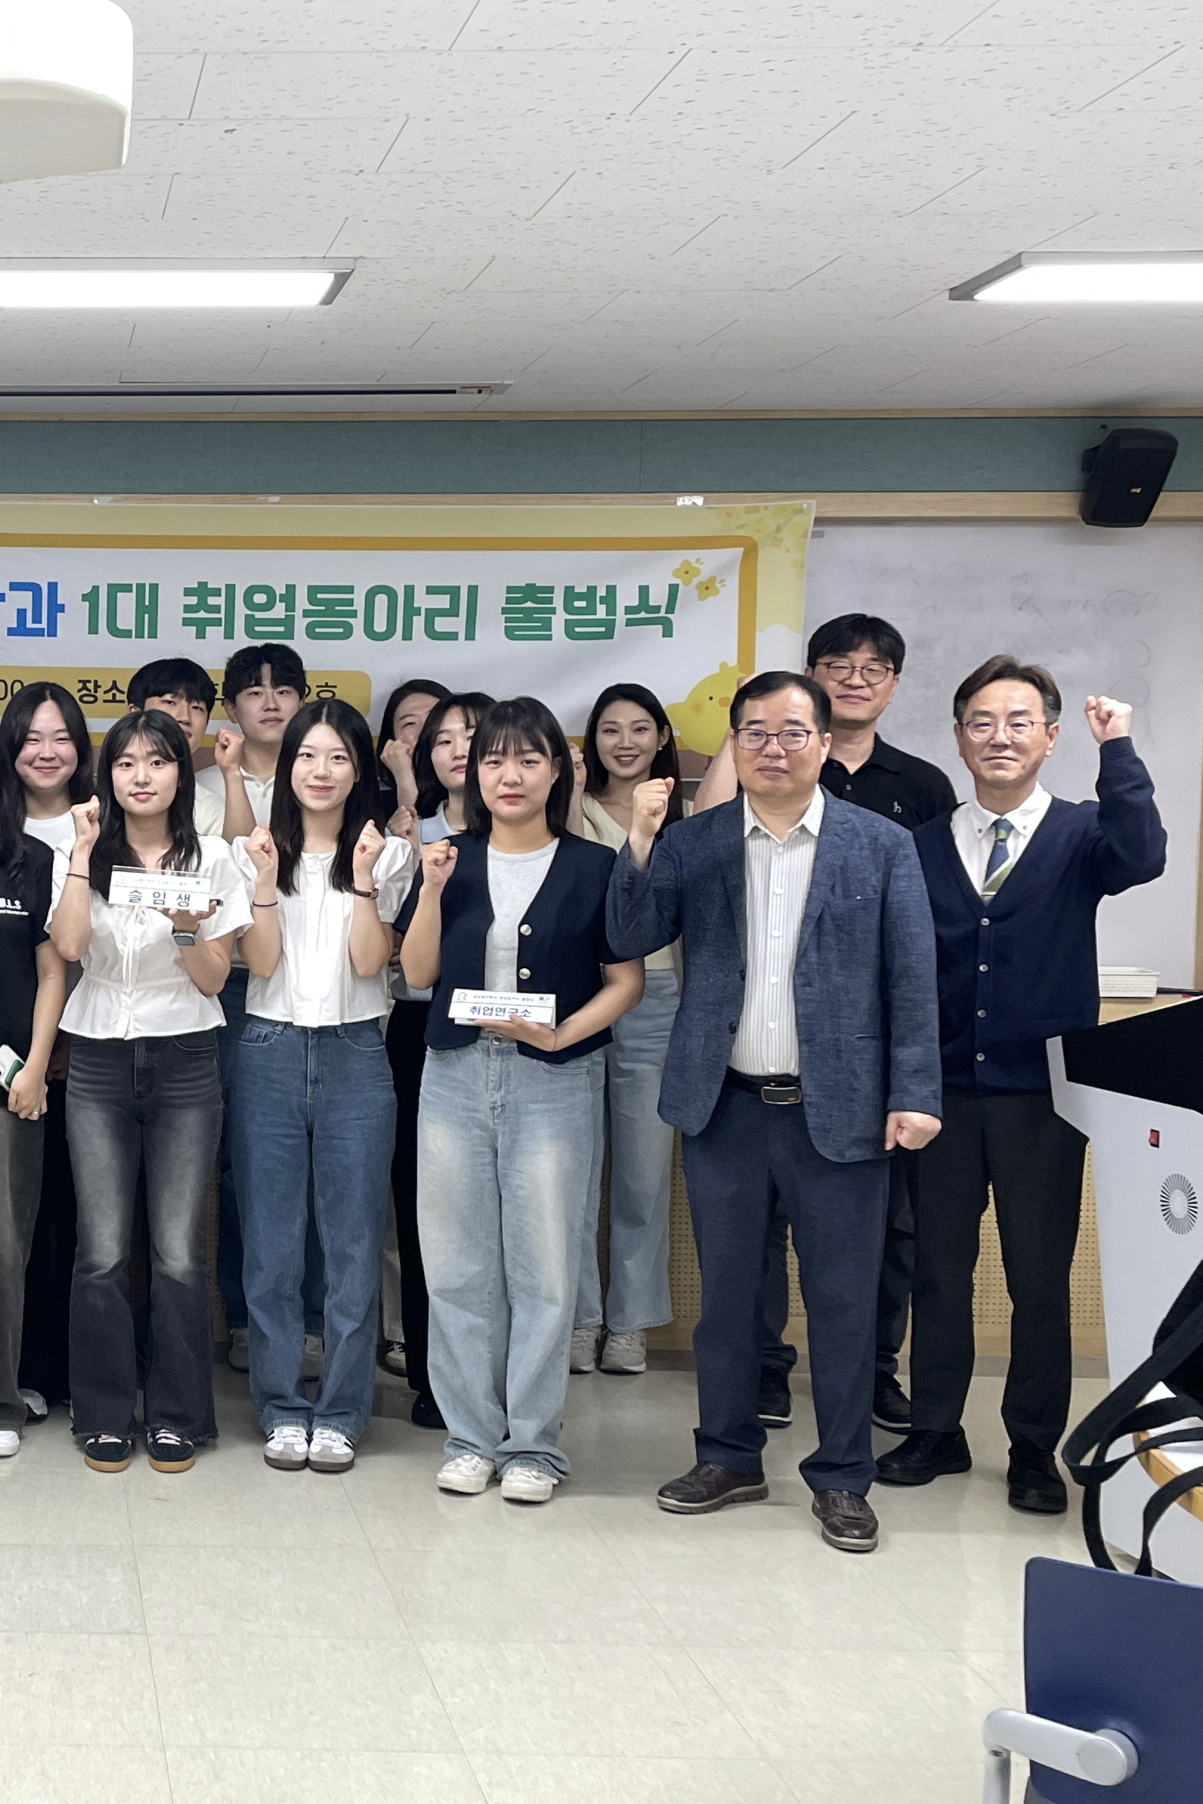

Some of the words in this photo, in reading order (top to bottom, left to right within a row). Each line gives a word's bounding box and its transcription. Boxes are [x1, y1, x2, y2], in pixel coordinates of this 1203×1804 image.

[81, 582, 159, 639] 1대
[182, 582, 478, 643] 취업동아리
[501, 582, 680, 640] 출범식
